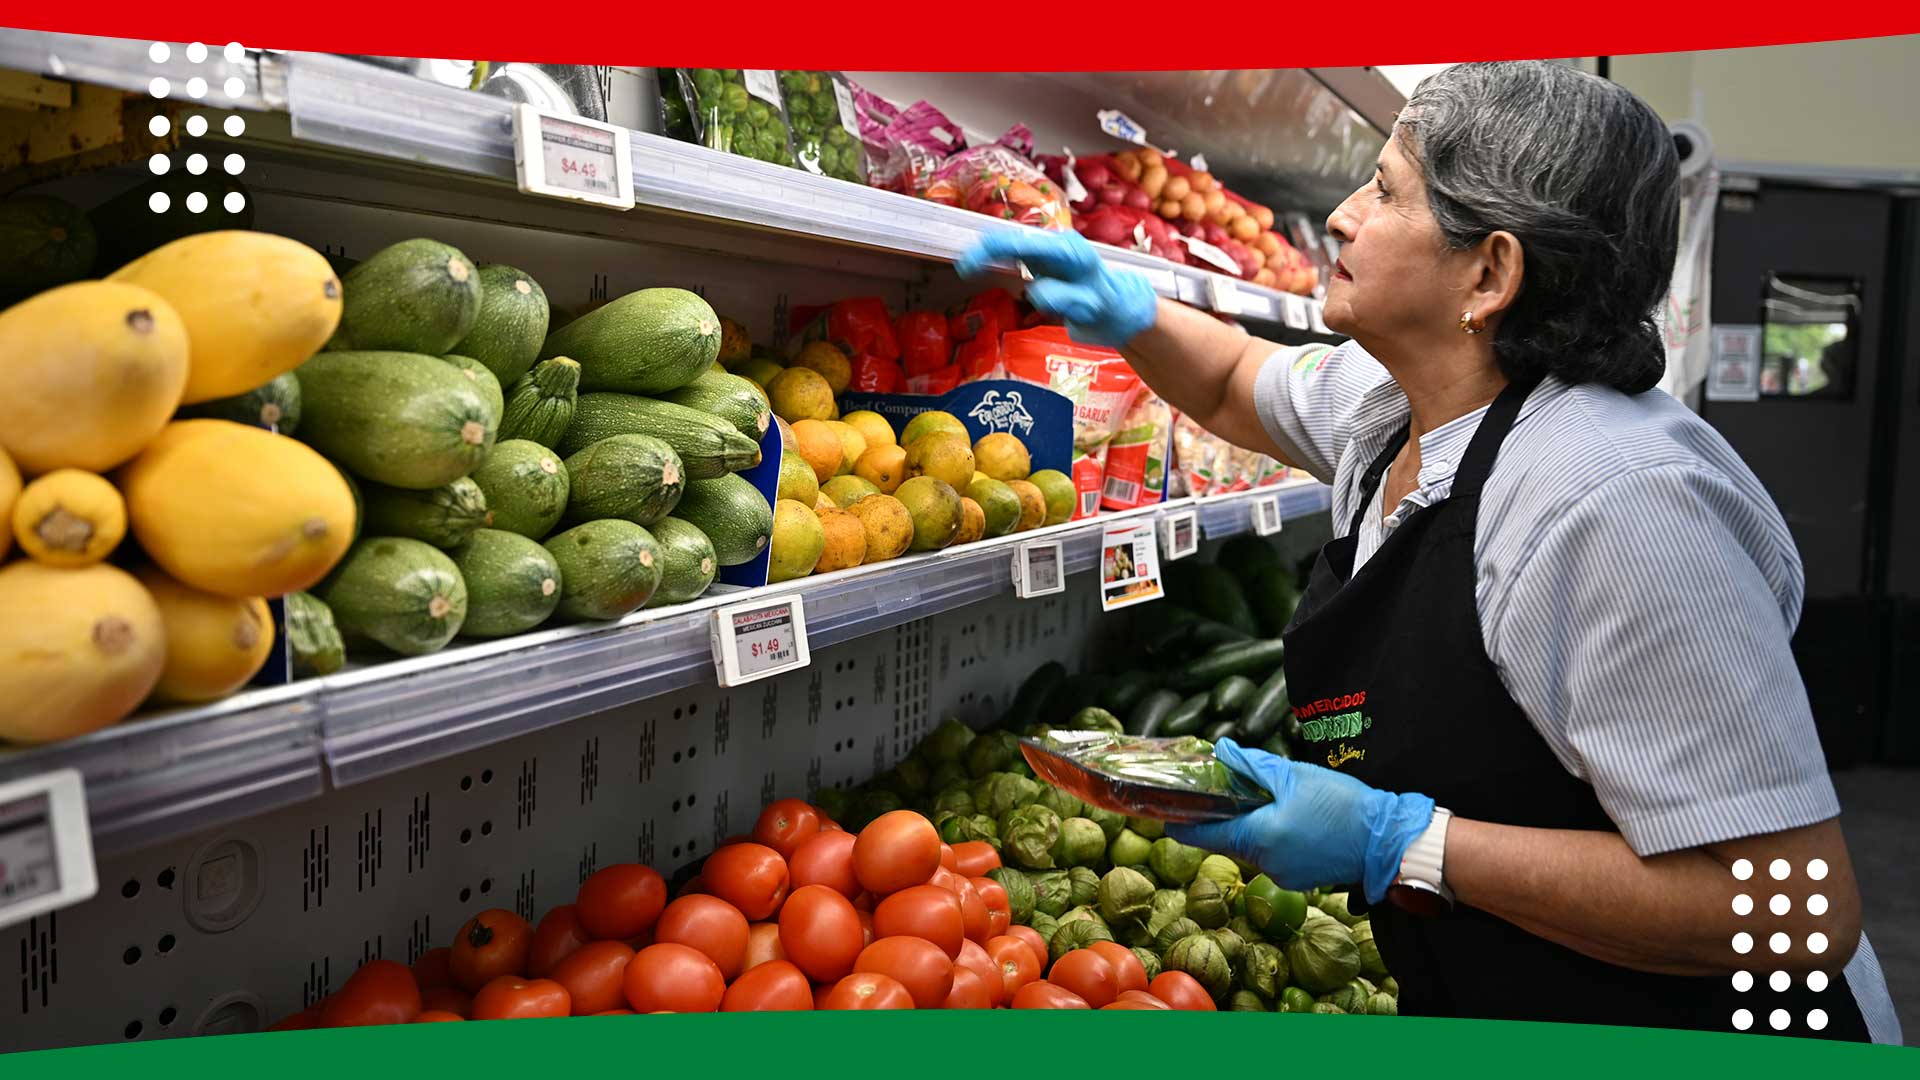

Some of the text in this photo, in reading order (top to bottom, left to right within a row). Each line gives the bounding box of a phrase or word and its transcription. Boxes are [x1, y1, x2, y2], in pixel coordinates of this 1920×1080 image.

[561, 158, 597, 178] $4.49
[1080, 405, 1110, 424] GARLIC
[751, 638, 779, 657] $1.49
